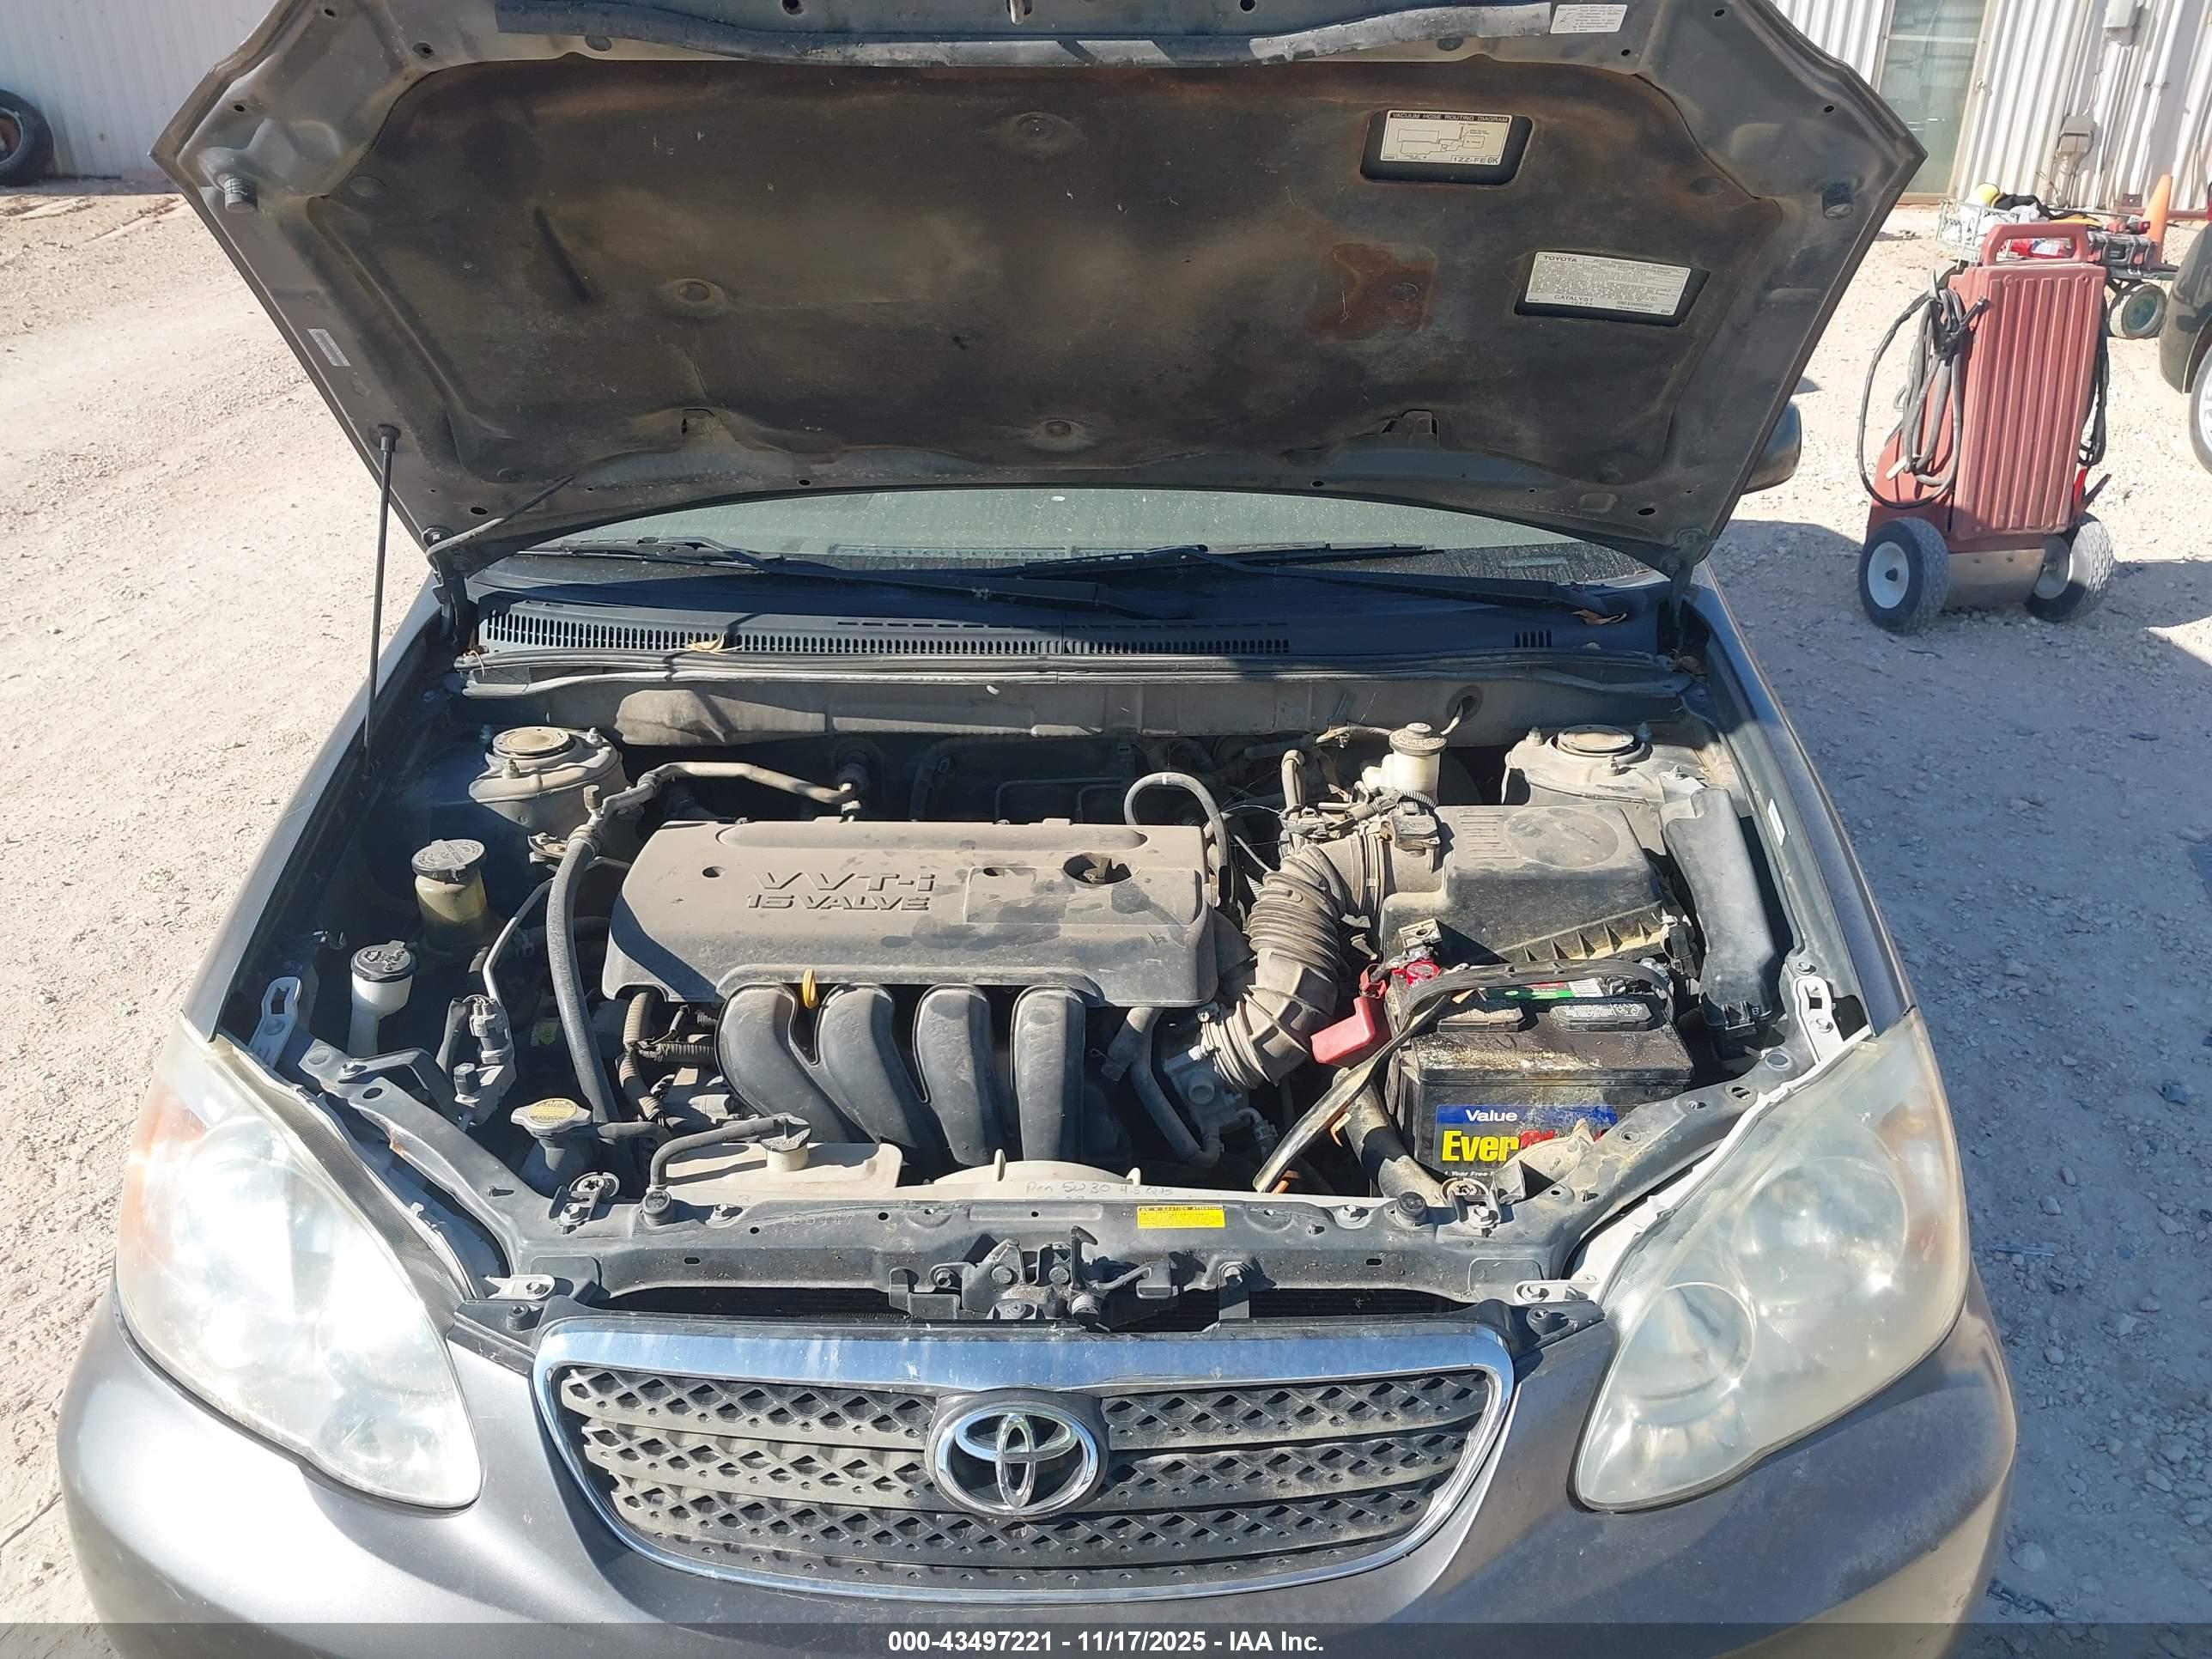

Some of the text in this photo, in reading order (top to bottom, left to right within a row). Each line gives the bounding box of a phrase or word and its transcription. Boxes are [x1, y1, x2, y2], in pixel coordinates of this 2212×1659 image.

[1553, 294, 1594, 302] CATALYST
[754, 871, 936, 892] VVT-i
[798, 895, 932, 911] VALVE
[1465, 1109, 1518, 1123] Value
